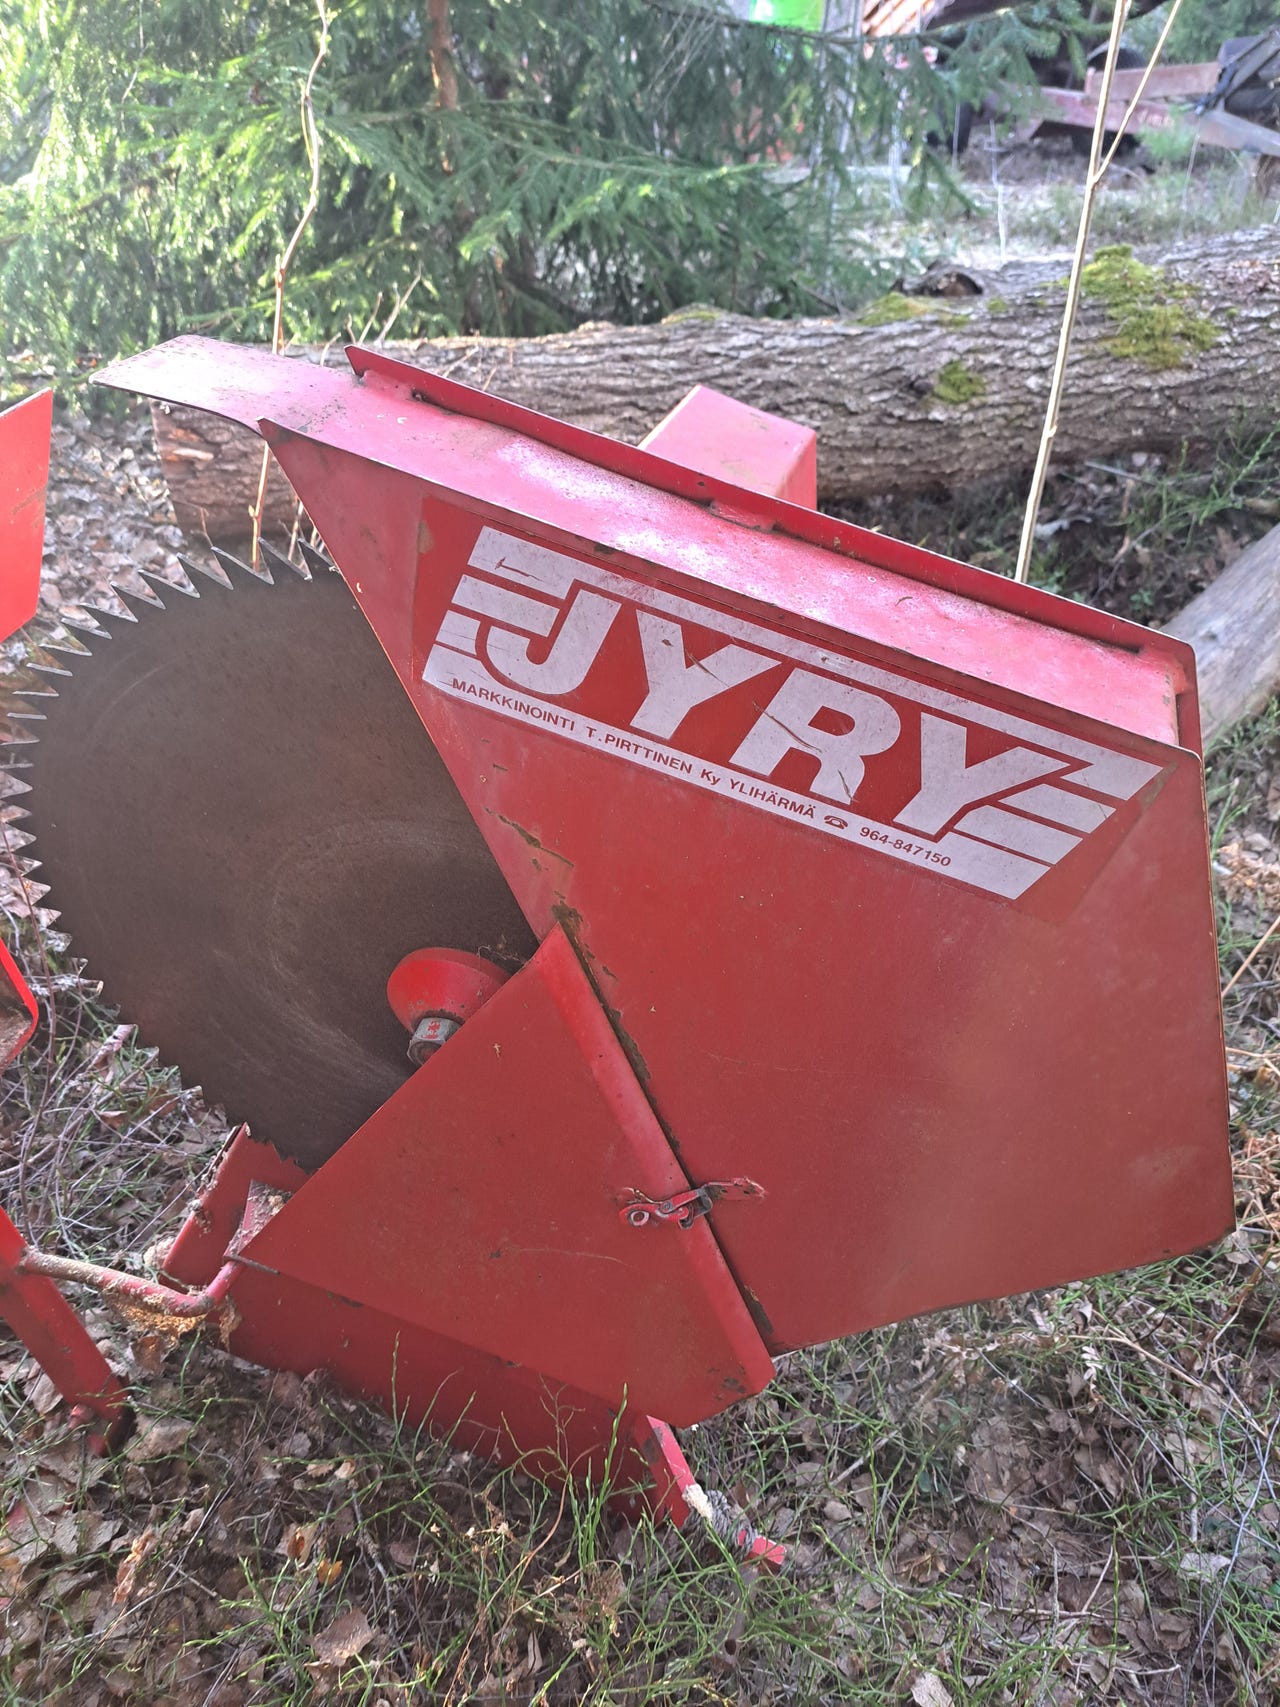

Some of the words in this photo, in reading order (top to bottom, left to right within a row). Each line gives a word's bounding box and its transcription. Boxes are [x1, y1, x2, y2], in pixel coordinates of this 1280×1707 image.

[451, 677, 575, 732] MARKKINOINTI
[700, 768, 721, 786] Ky
[729, 778, 816, 819] YLIHÄRMÄ
[859, 826, 952, 868] 964-847150
[485, 588, 1070, 837] JYRY
